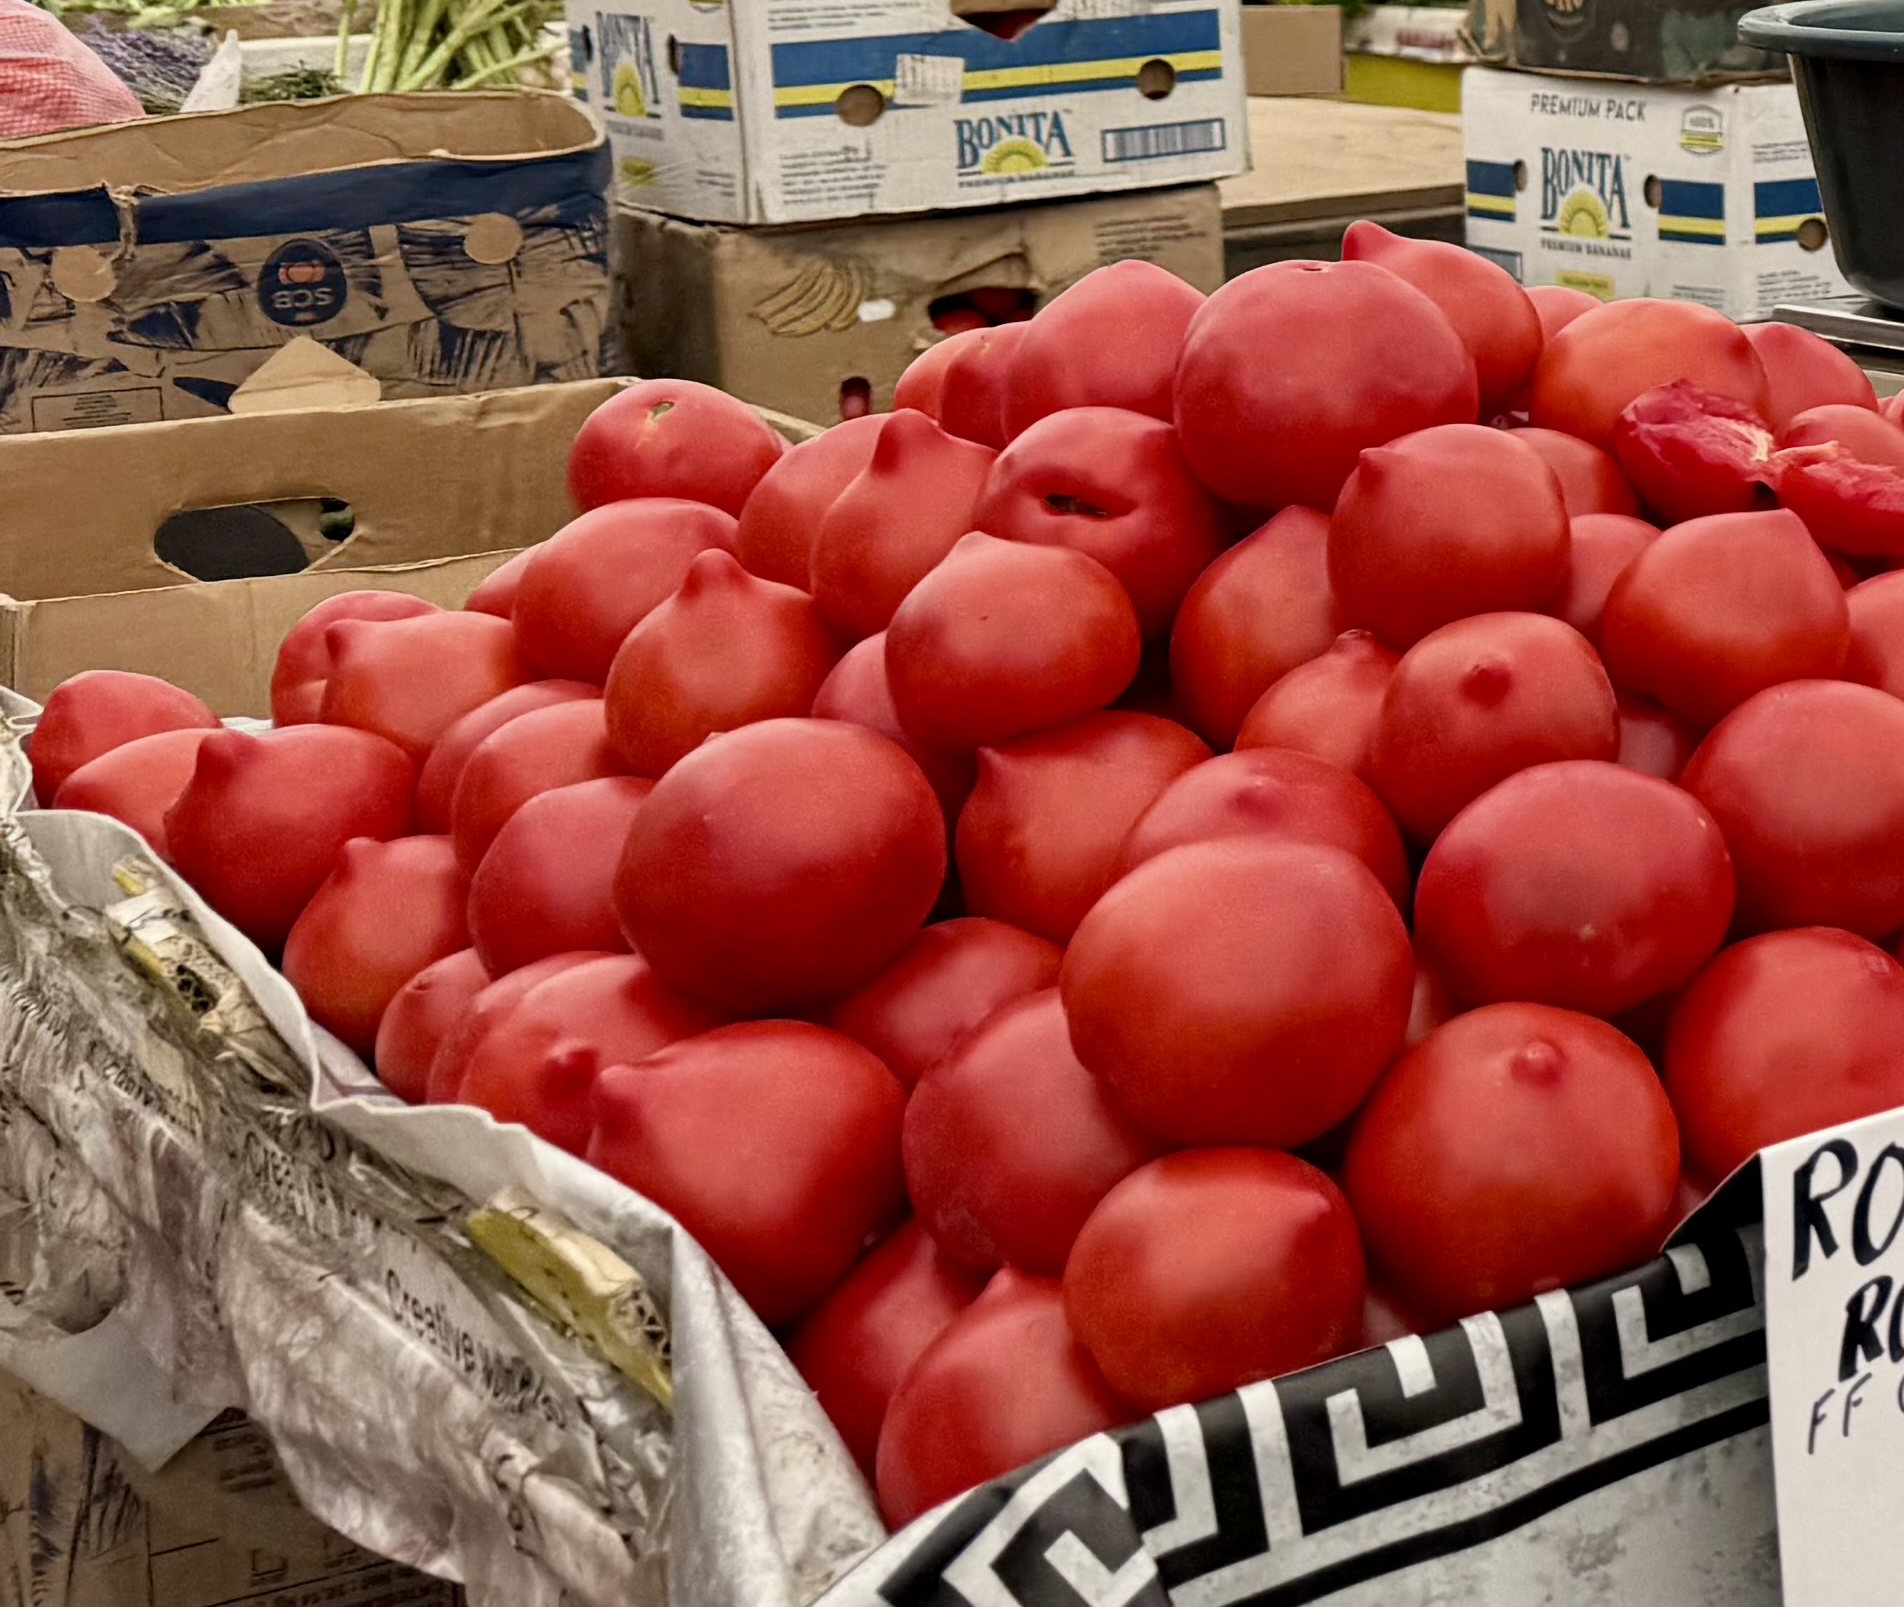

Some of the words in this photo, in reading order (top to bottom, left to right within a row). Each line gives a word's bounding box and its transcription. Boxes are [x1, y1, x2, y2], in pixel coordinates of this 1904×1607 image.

[953, 111, 1074, 170] BONITA
[1531, 94, 1600, 118] PREMIUM
[1606, 97, 1647, 122] PACK
[1541, 146, 1631, 229] BONITA
[1807, 1371, 1874, 1456] FF
